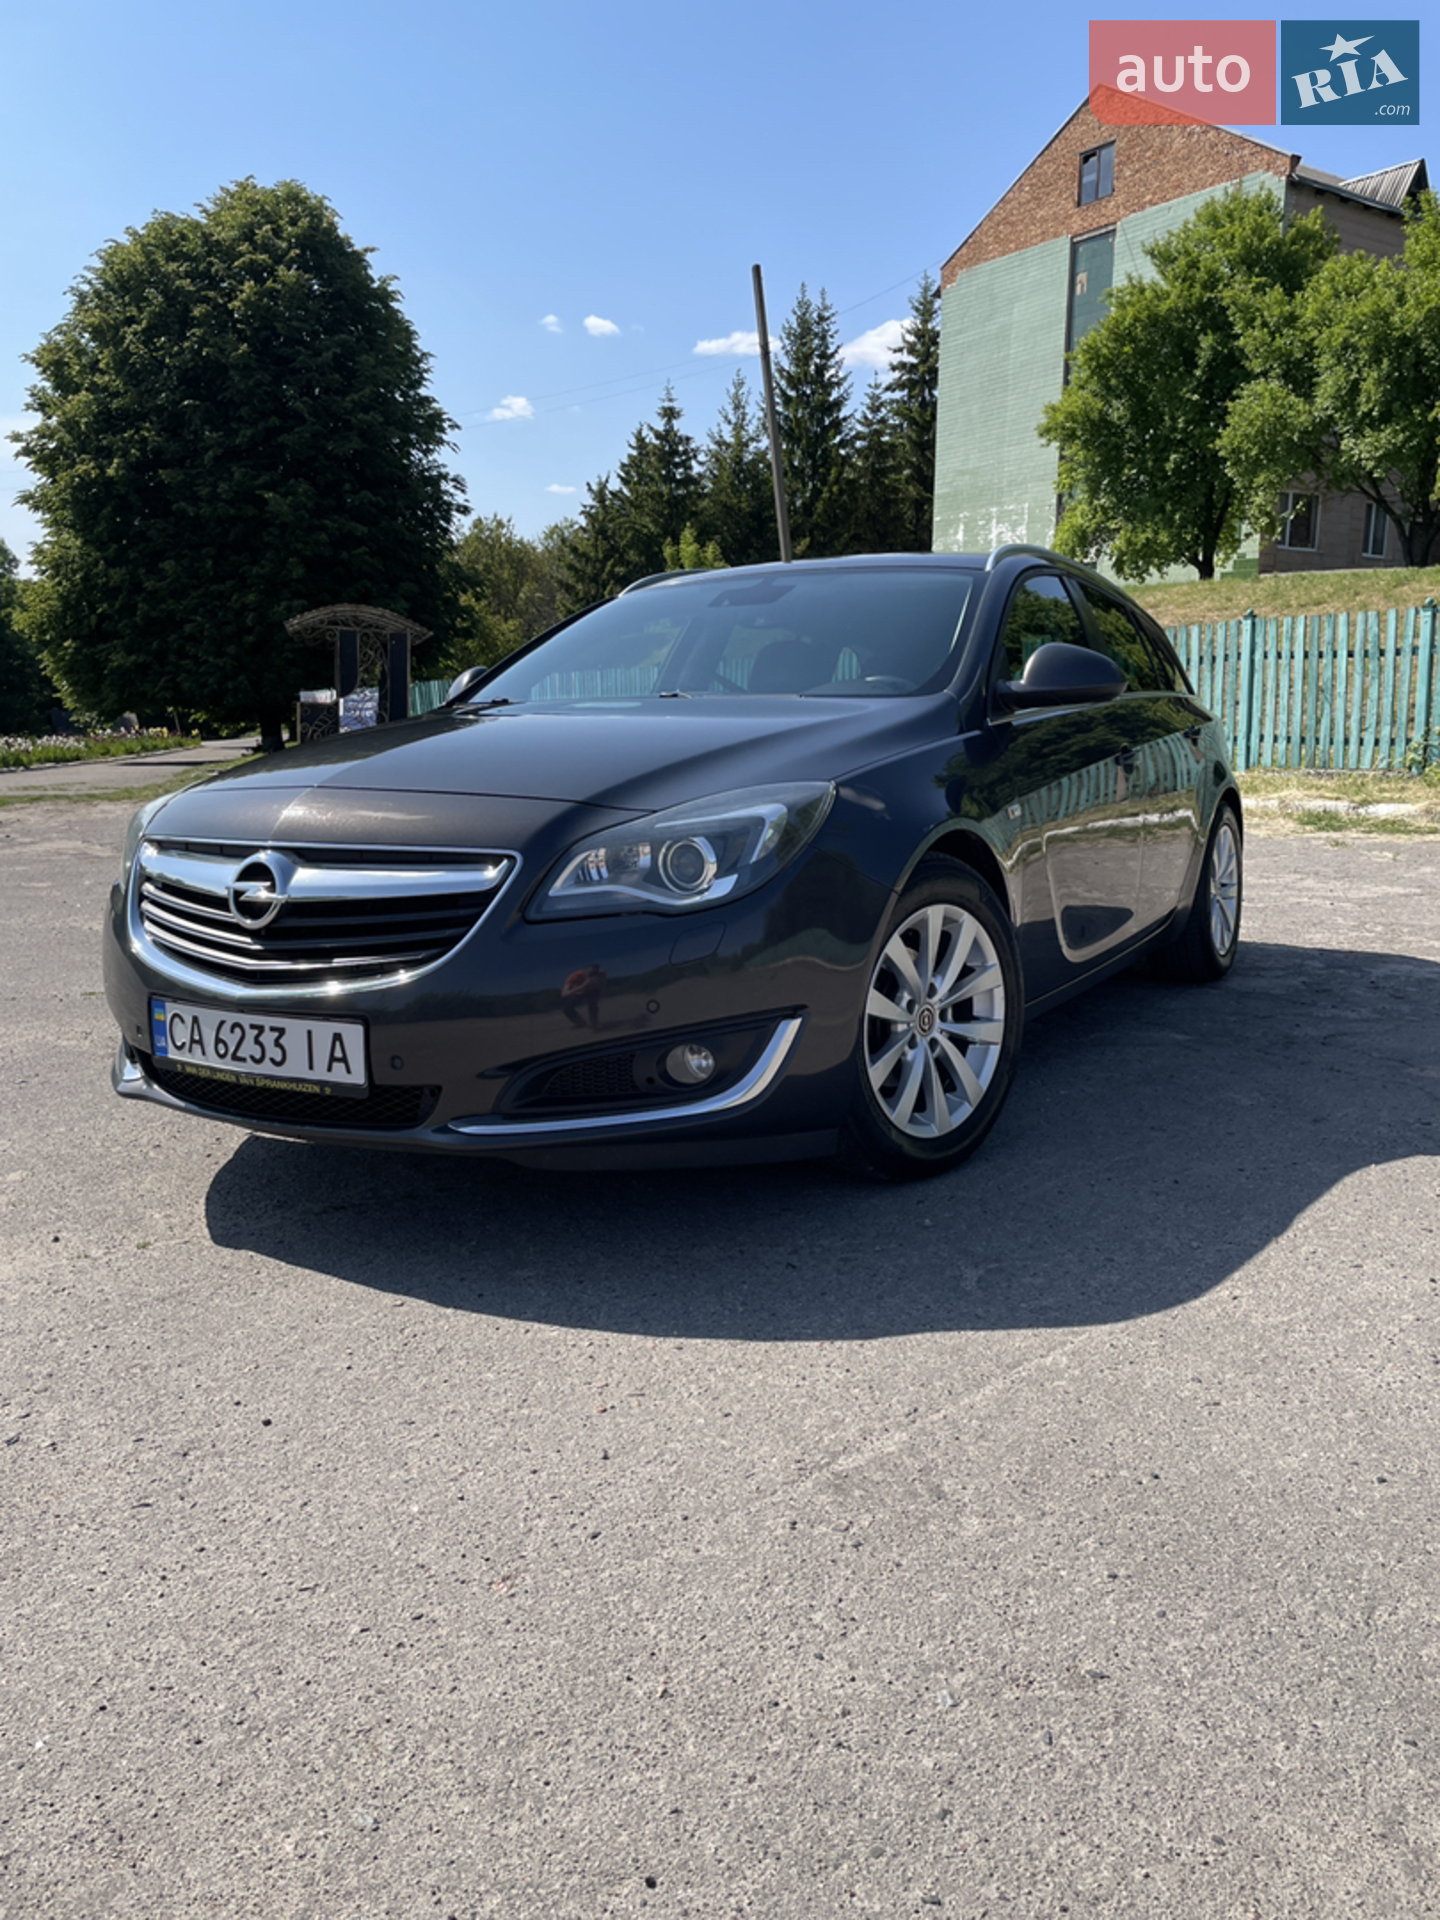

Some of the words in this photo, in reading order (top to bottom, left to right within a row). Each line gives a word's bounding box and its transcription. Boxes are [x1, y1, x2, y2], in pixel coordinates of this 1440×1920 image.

[169, 1012, 206, 1056] CA
[214, 1020, 287, 1068] 6233
[307, 1029, 352, 1075] IA
